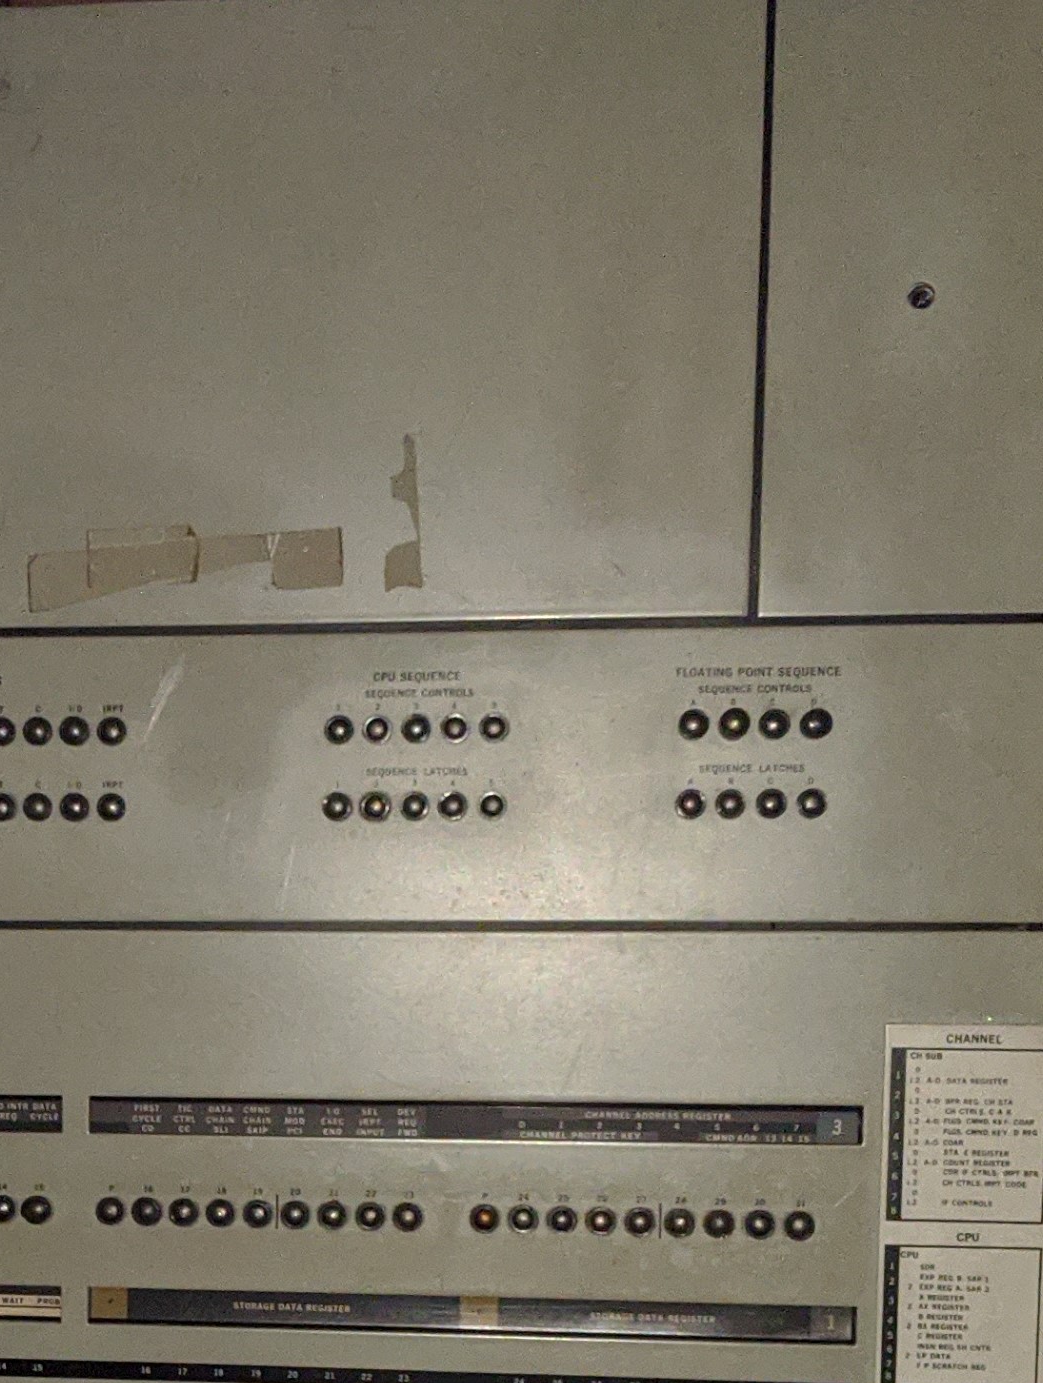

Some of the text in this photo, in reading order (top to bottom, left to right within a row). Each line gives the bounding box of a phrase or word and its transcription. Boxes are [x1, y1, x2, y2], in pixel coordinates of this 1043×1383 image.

[373, 671, 461, 683] CPU SEQUENCE
[676, 666, 841, 680] FLOATING POINT SEQUENCE
[365, 688, 474, 700] SEQUENCE CONTROLS
[698, 684, 812, 696] SEQUENCE CONTROLS
[367, 768, 416, 778] SEQUENCE
[698, 764, 805, 775] SEQUENCE LATCHES
[945, 1034, 1004, 1045] CHANNEL
[910, 1052, 943, 1061] CH SUB
[32, 1102, 57, 1111] DATA
[133, 1103, 160, 1112] FIRST
[207, 1104, 232, 1113] DATA
[30, 1112, 59, 1122] CYCLE
[131, 1114, 162, 1124] CYCLE
[172, 1115, 196, 1125] CTRL
[205, 1115, 235, 1125] CHAIN
[585, 1110, 731, 1121] CHANNEL ADDRESS REGISTER
[242, 1116, 272, 1126] CHAIN
[247, 1126, 268, 1136] SKIP
[832, 1118, 844, 1136] 3
[519, 1130, 641, 1141] CHANNEL PROTECT KEY
[956, 1232, 980, 1242] CPU
[900, 1251, 919, 1260] CPU
[1, 1296, 24, 1305] WAIT
[232, 1301, 351, 1313] STORAGE DATA REGISTER
[590, 1311, 716, 1324] STORAGE DATA REGISTER
[828, 1315, 835, 1330] 1
